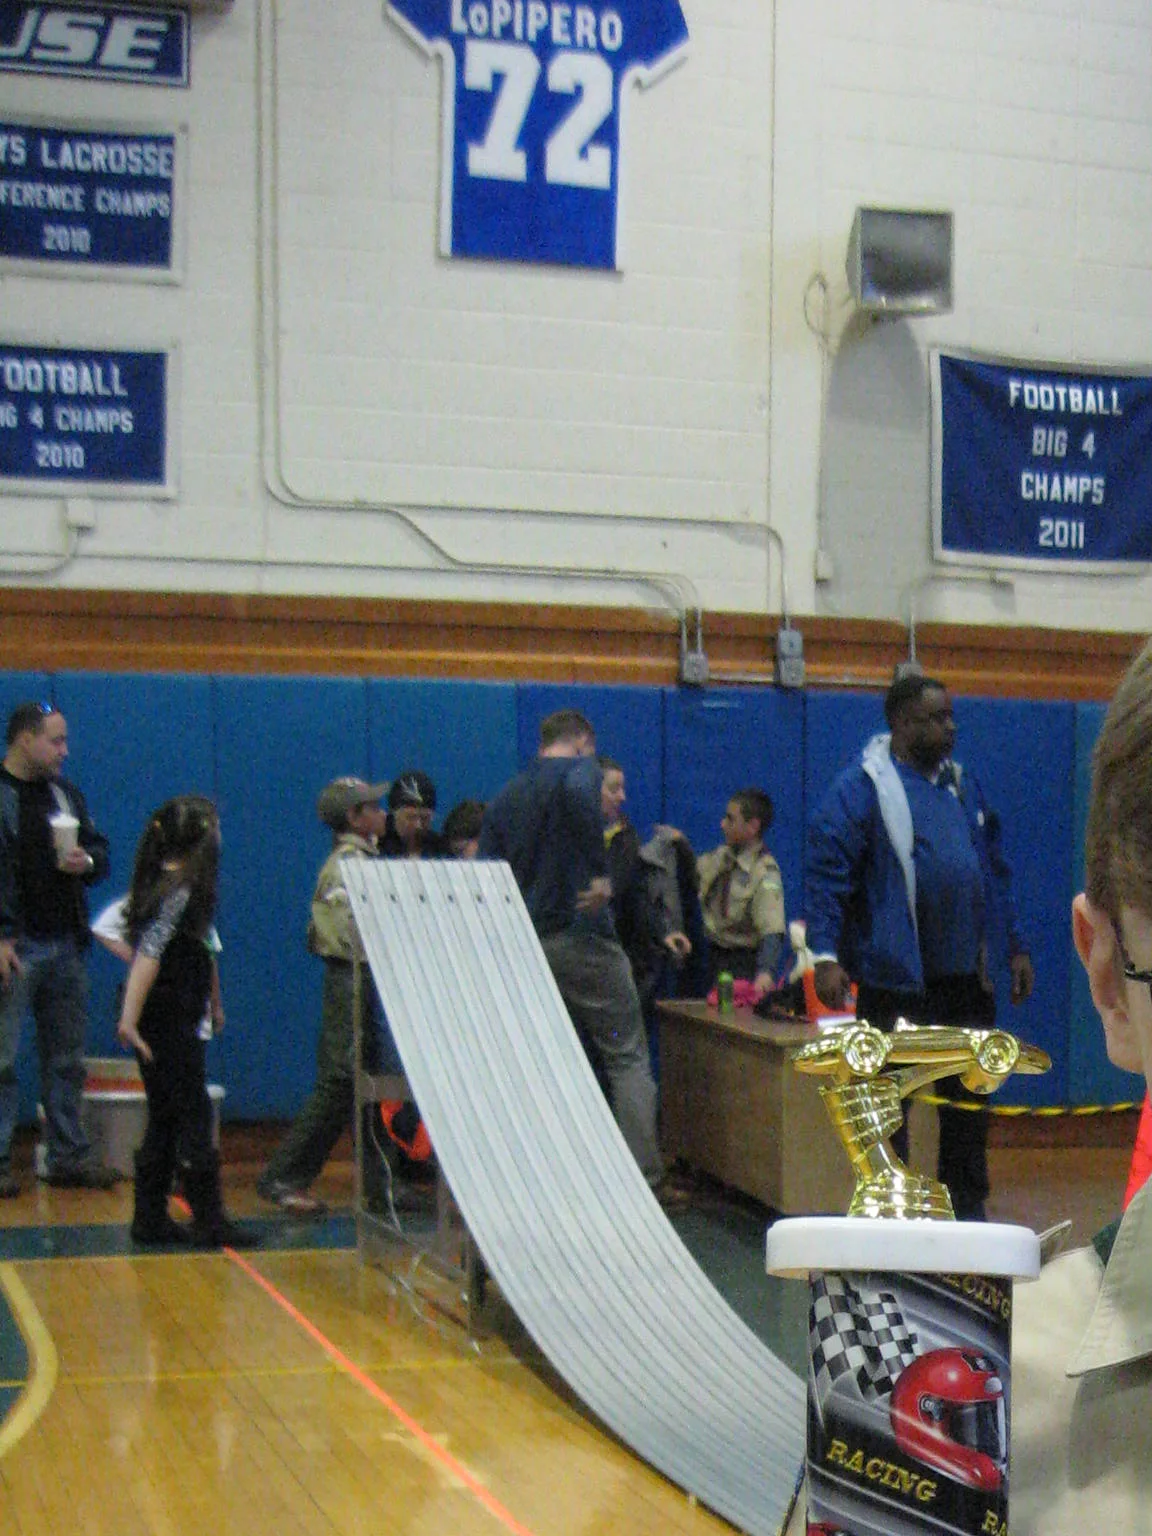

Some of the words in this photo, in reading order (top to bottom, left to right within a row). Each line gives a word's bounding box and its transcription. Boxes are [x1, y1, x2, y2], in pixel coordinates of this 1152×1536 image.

[464, 37, 614, 191] 72
[41, 138, 174, 179] LACROSSE
[95, 187, 170, 218] CHAMPS
[43, 223, 91, 253] 2010
[0, 357, 128, 397] OOTBALL
[1008, 378, 1123, 416] FOOTBALL
[55, 405, 134, 434] CHAMPS
[35, 441, 85, 469] 2010
[1032, 427, 1068, 458] BIG
[1081, 431, 1097, 459] 4
[1020, 471, 1105, 505] CHAMPS
[1038, 518, 1085, 549] 2011
[826, 1439, 938, 1502] RACING
